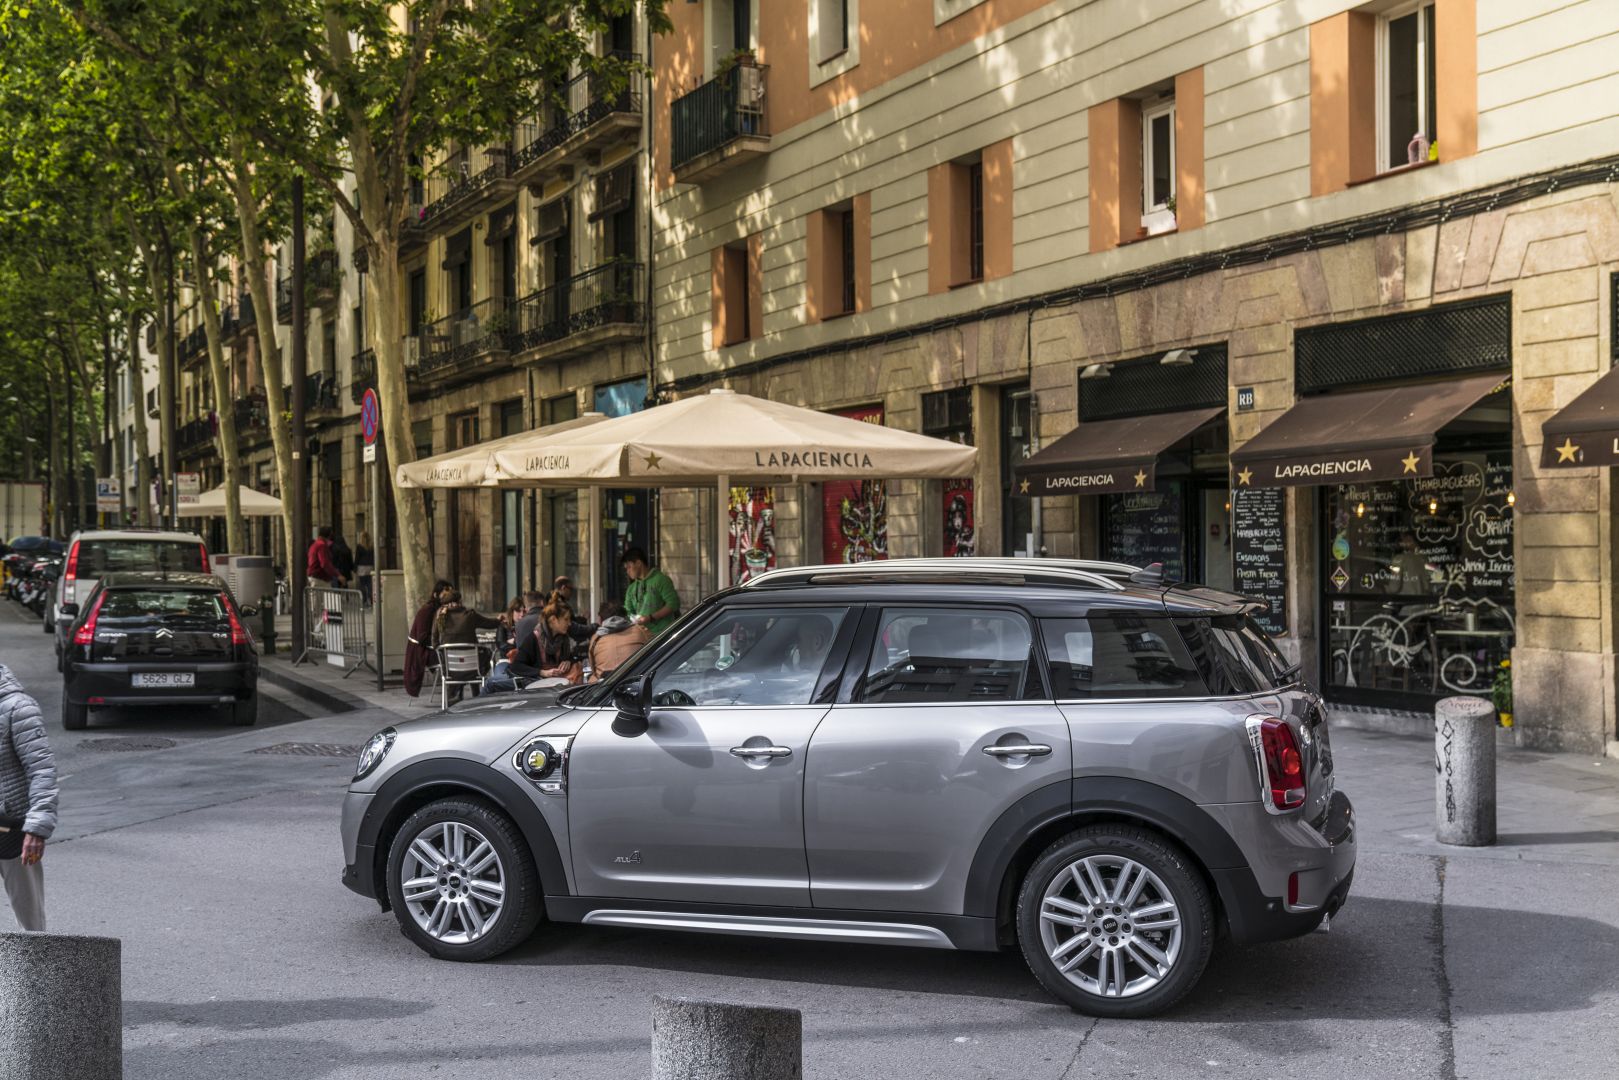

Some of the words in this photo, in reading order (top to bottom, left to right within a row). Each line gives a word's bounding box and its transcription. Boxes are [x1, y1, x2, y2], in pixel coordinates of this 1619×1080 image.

[1239, 393, 1253, 406] RB
[525, 455, 570, 472] LAPACIENCIA
[755, 451, 873, 468] LAPACIENCIA
[426, 468, 463, 482] LAPACIENCIA
[1275, 459, 1372, 478] LAPACIENCIA
[1046, 473, 1114, 488] LAPACIENCIA
[142, 673, 168, 684] 5629
[173, 673, 193, 684] GLZ
